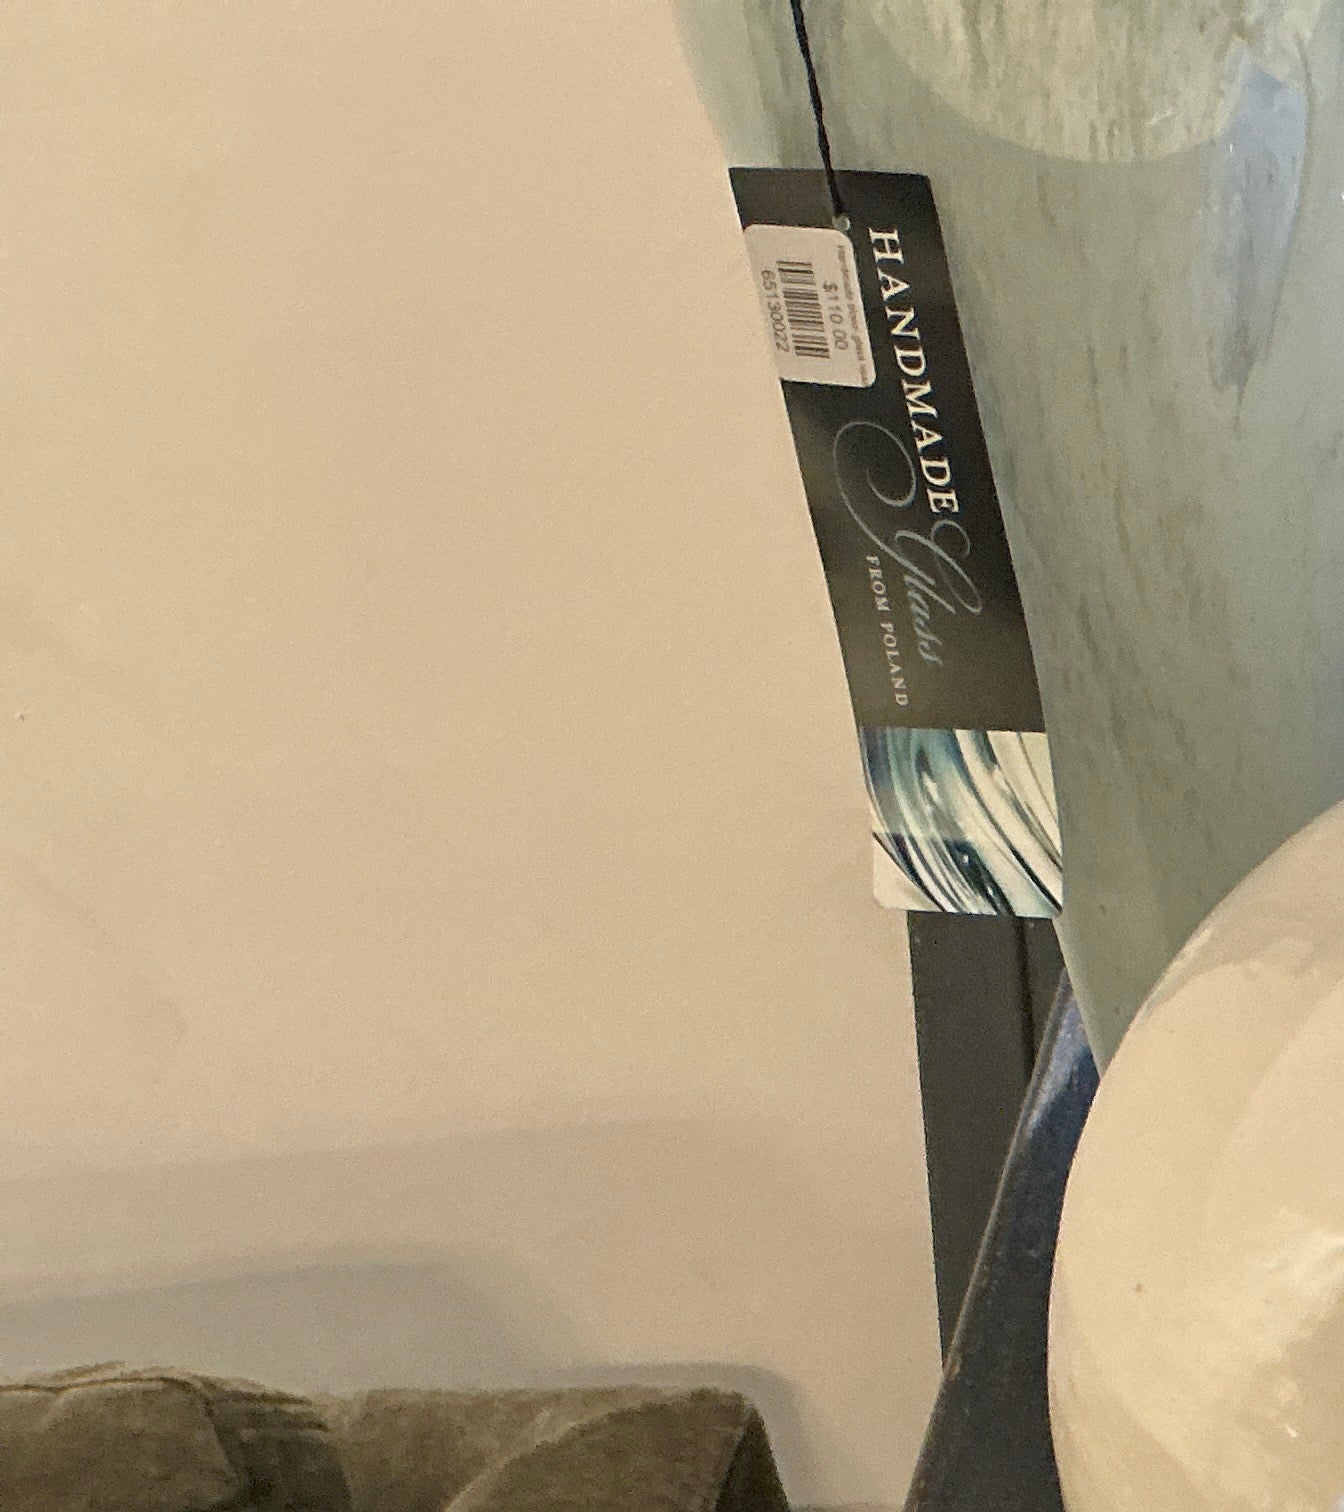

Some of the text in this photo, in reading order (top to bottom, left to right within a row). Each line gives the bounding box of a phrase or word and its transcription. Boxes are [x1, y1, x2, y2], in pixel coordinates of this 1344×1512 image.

[761, 270, 790, 352] 65130022
[868, 227, 960, 514] HANDMADE
[833, 421, 982, 666] Glass
[866, 554, 909, 707] FROM POLAND
